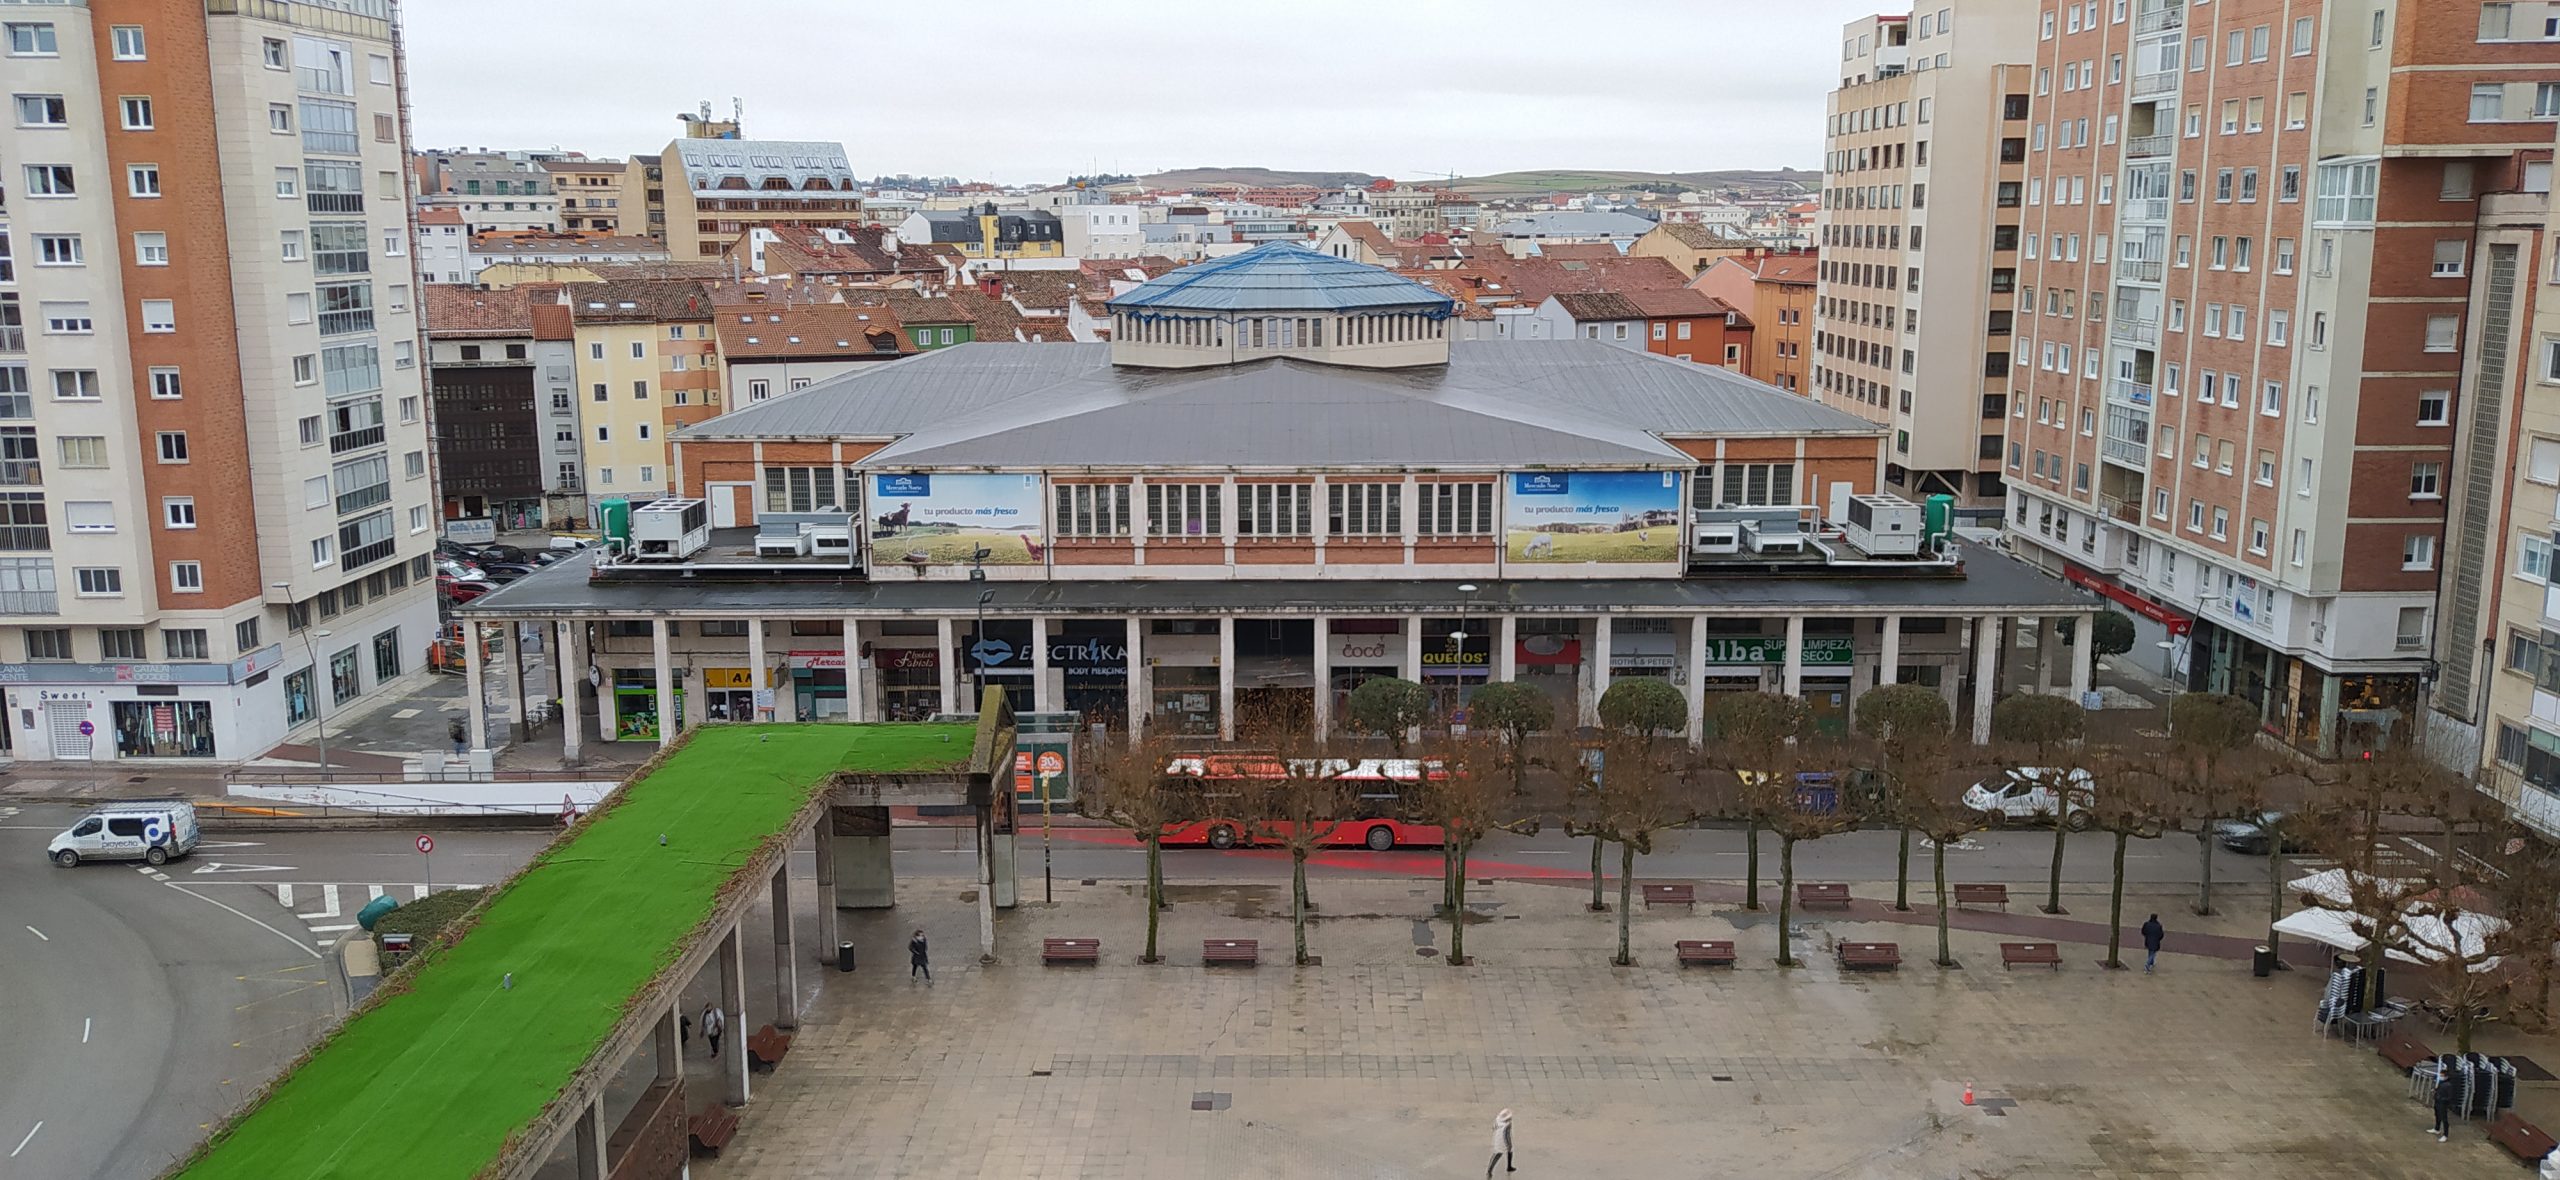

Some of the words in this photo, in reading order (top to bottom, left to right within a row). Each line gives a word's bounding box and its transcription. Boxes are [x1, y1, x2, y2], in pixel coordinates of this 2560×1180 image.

[924, 507, 934, 515] tu
[935, 507, 973, 517] producto
[975, 507, 992, 515] más
[993, 507, 1018, 517] fresco
[1525, 505, 1534, 513] tu
[1535, 505, 1574, 515] producto
[1575, 504, 1593, 513] más
[1594, 504, 1619, 515] fresco
[1803, 640, 1852, 650] LIMPIEZA
[1343, 645, 1384, 657] COCO
[1802, 651, 1833, 661] SECO
[1647, 658, 1673, 666] PETER
[133, 664, 181, 673] CATALANA
[1068, 667, 1089, 676] BODY
[1091, 667, 1127, 676] PIERCING
[40, 690, 86, 700] Sweet
